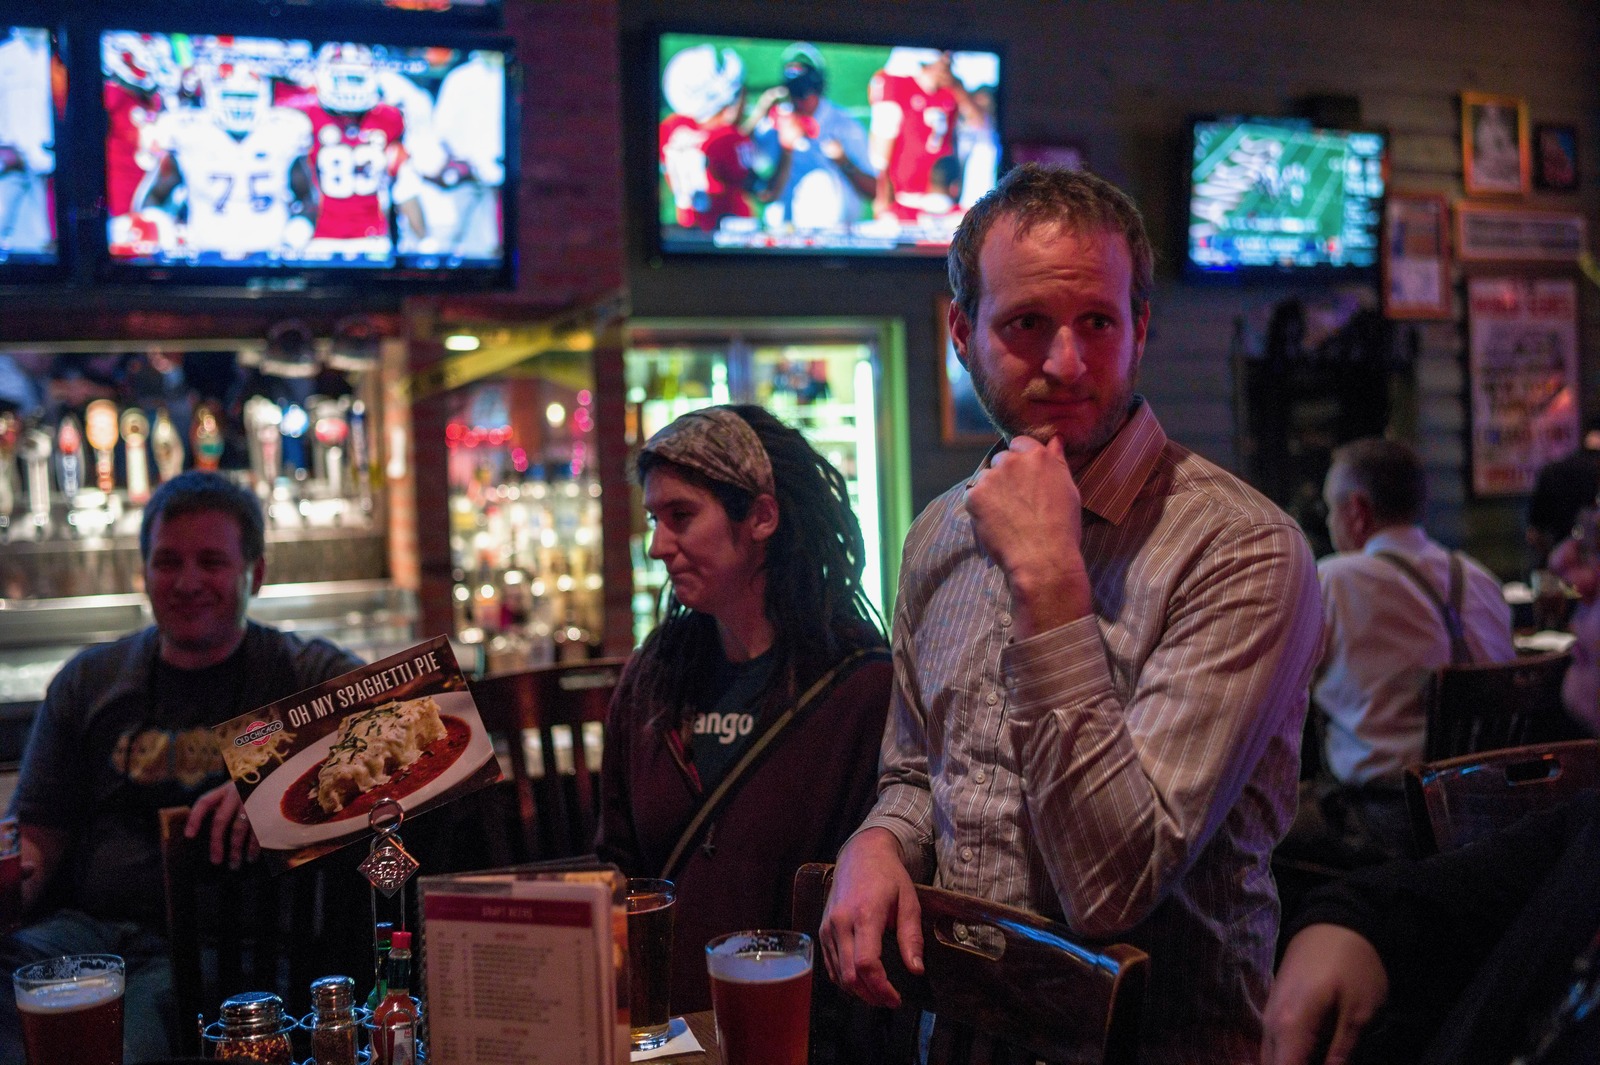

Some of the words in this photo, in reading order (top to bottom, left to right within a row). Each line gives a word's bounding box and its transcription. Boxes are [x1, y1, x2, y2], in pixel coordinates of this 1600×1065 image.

[288, 708, 312, 729] OH
[311, 694, 335, 717] MY
[337, 662, 413, 709] SPAGHETTI
[414, 651, 441, 679] PIE
[235, 734, 250, 746] OLD
[249, 722, 282, 740] CHICAGO
